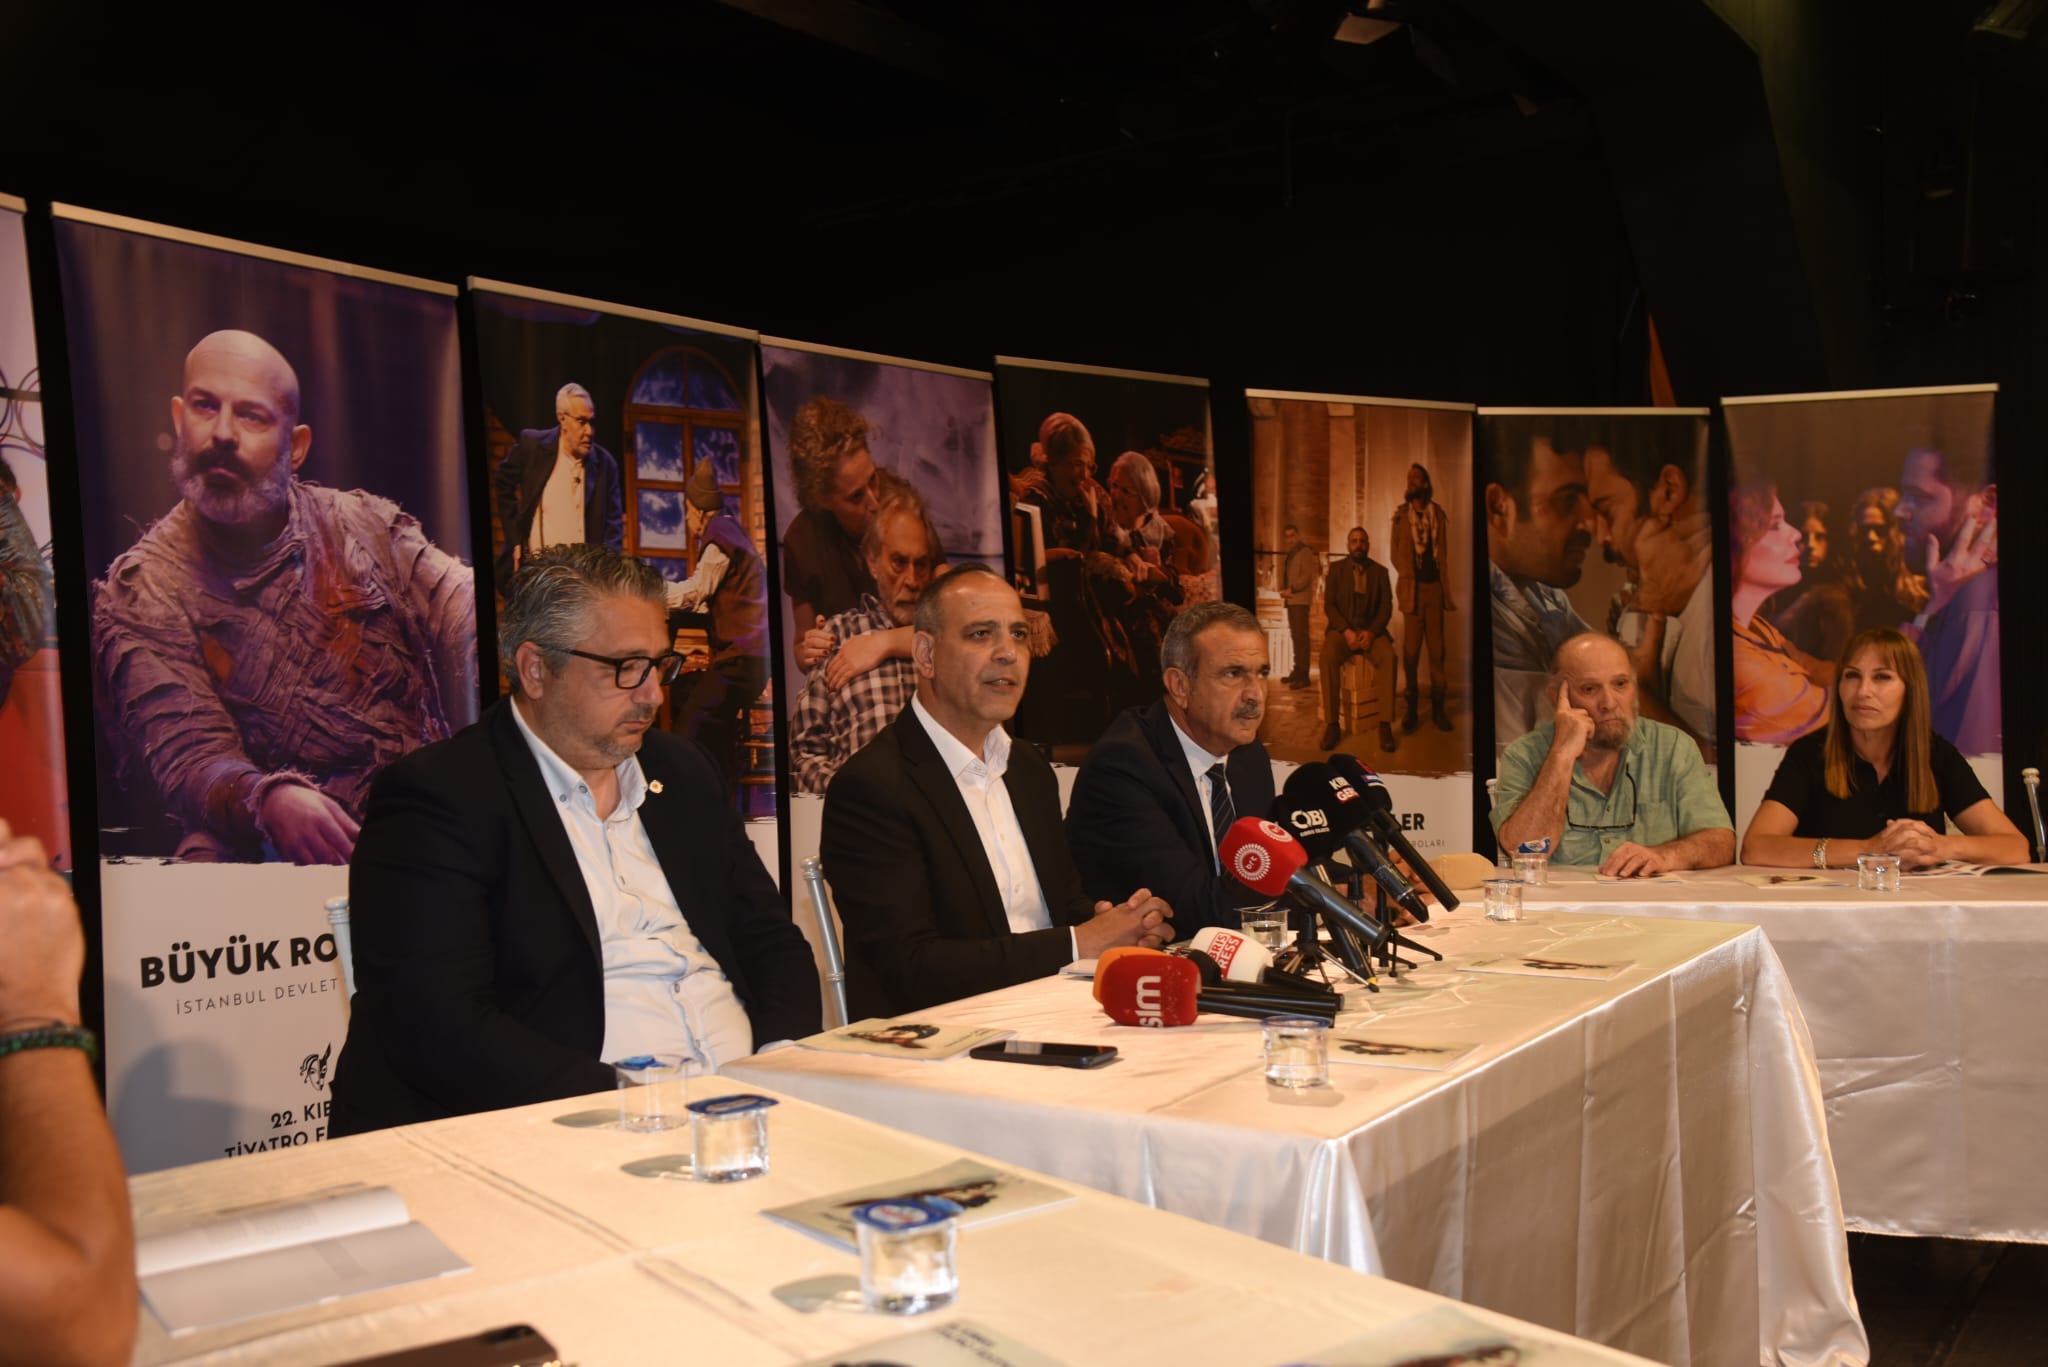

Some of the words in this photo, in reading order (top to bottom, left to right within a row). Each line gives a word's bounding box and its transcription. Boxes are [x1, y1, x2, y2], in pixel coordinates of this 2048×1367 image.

[1394, 813, 1425, 831] ER
[140, 934, 281, 989] BÜYÜK
[290, 933, 338, 967] RO
[1217, 937, 1239, 969] RESS
[176, 990, 266, 1015] İSTANBUL
[274, 978, 338, 1000] DEVLET
[1134, 975, 1164, 1028] sim
[271, 1110, 297, 1129] 22.
